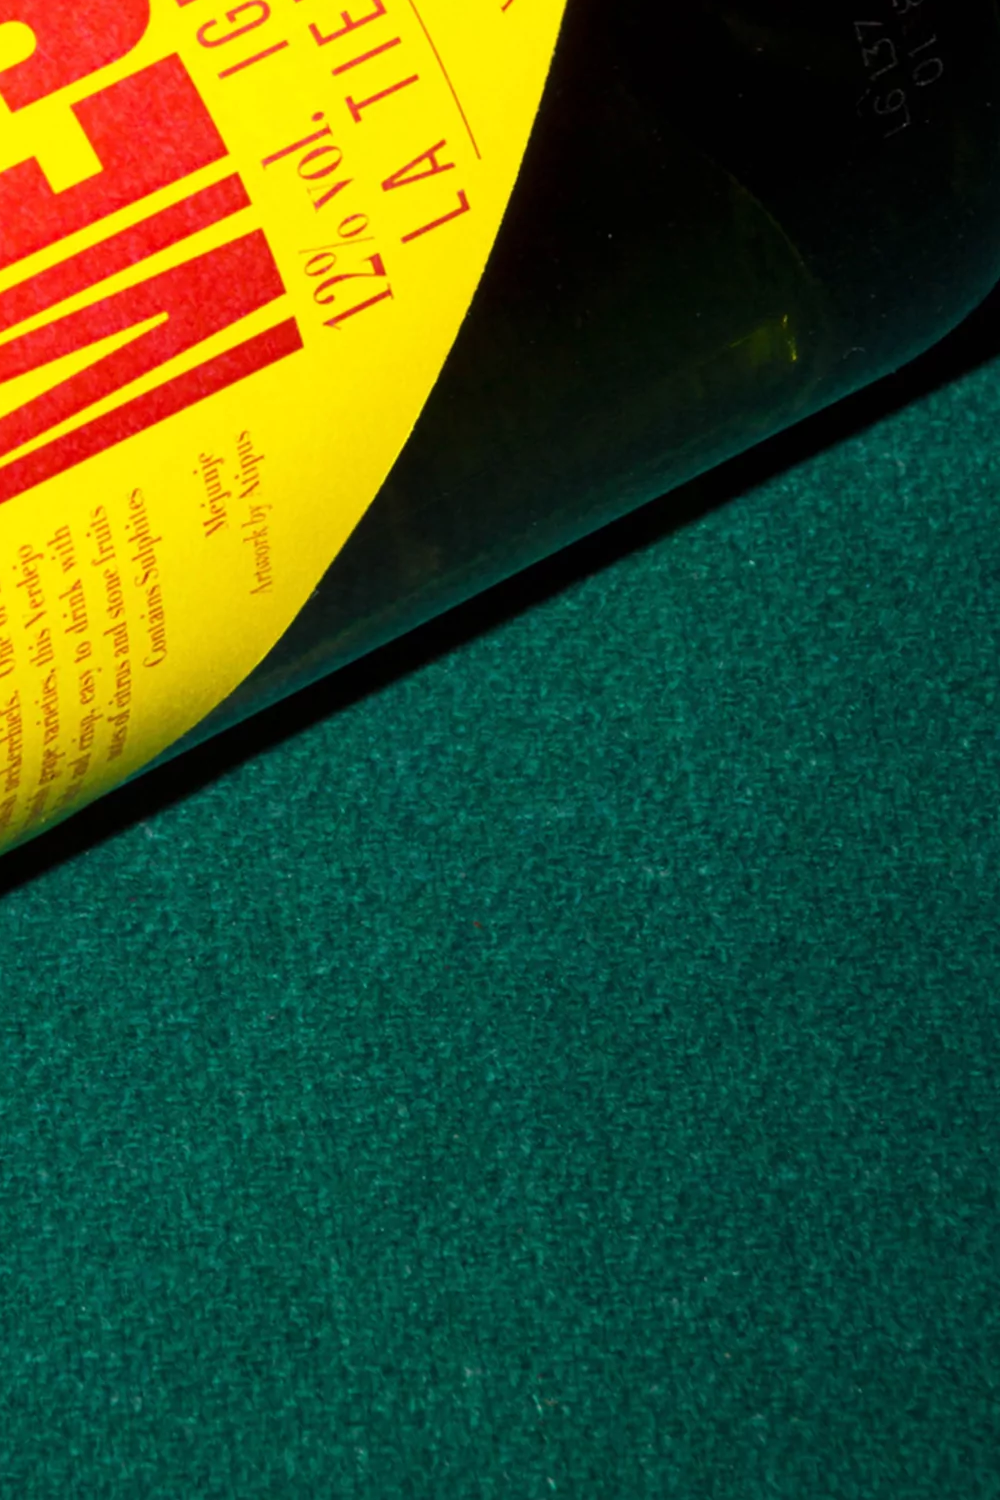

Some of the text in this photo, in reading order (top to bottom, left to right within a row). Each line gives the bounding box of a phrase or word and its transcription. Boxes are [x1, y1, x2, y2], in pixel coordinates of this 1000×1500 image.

[260, 110, 354, 214] vol.
[379, 138, 472, 244] LA
[298, 212, 394, 331] 12%
[192, 451, 233, 539] Mejunje
[233, 429, 274, 596] Artwork by Atipus
[46, 524, 78, 574] with
[85, 504, 117, 567] fruits
[11, 543, 48, 630] Verdejo
[58, 577, 89, 636] drink
[102, 564, 126, 620] stone
[124, 486, 168, 669] Contains Sulphites
[28, 627, 55, 668] this
[73, 639, 93, 665] to
[102, 620, 131, 659] and
[78, 667, 103, 706] easy
